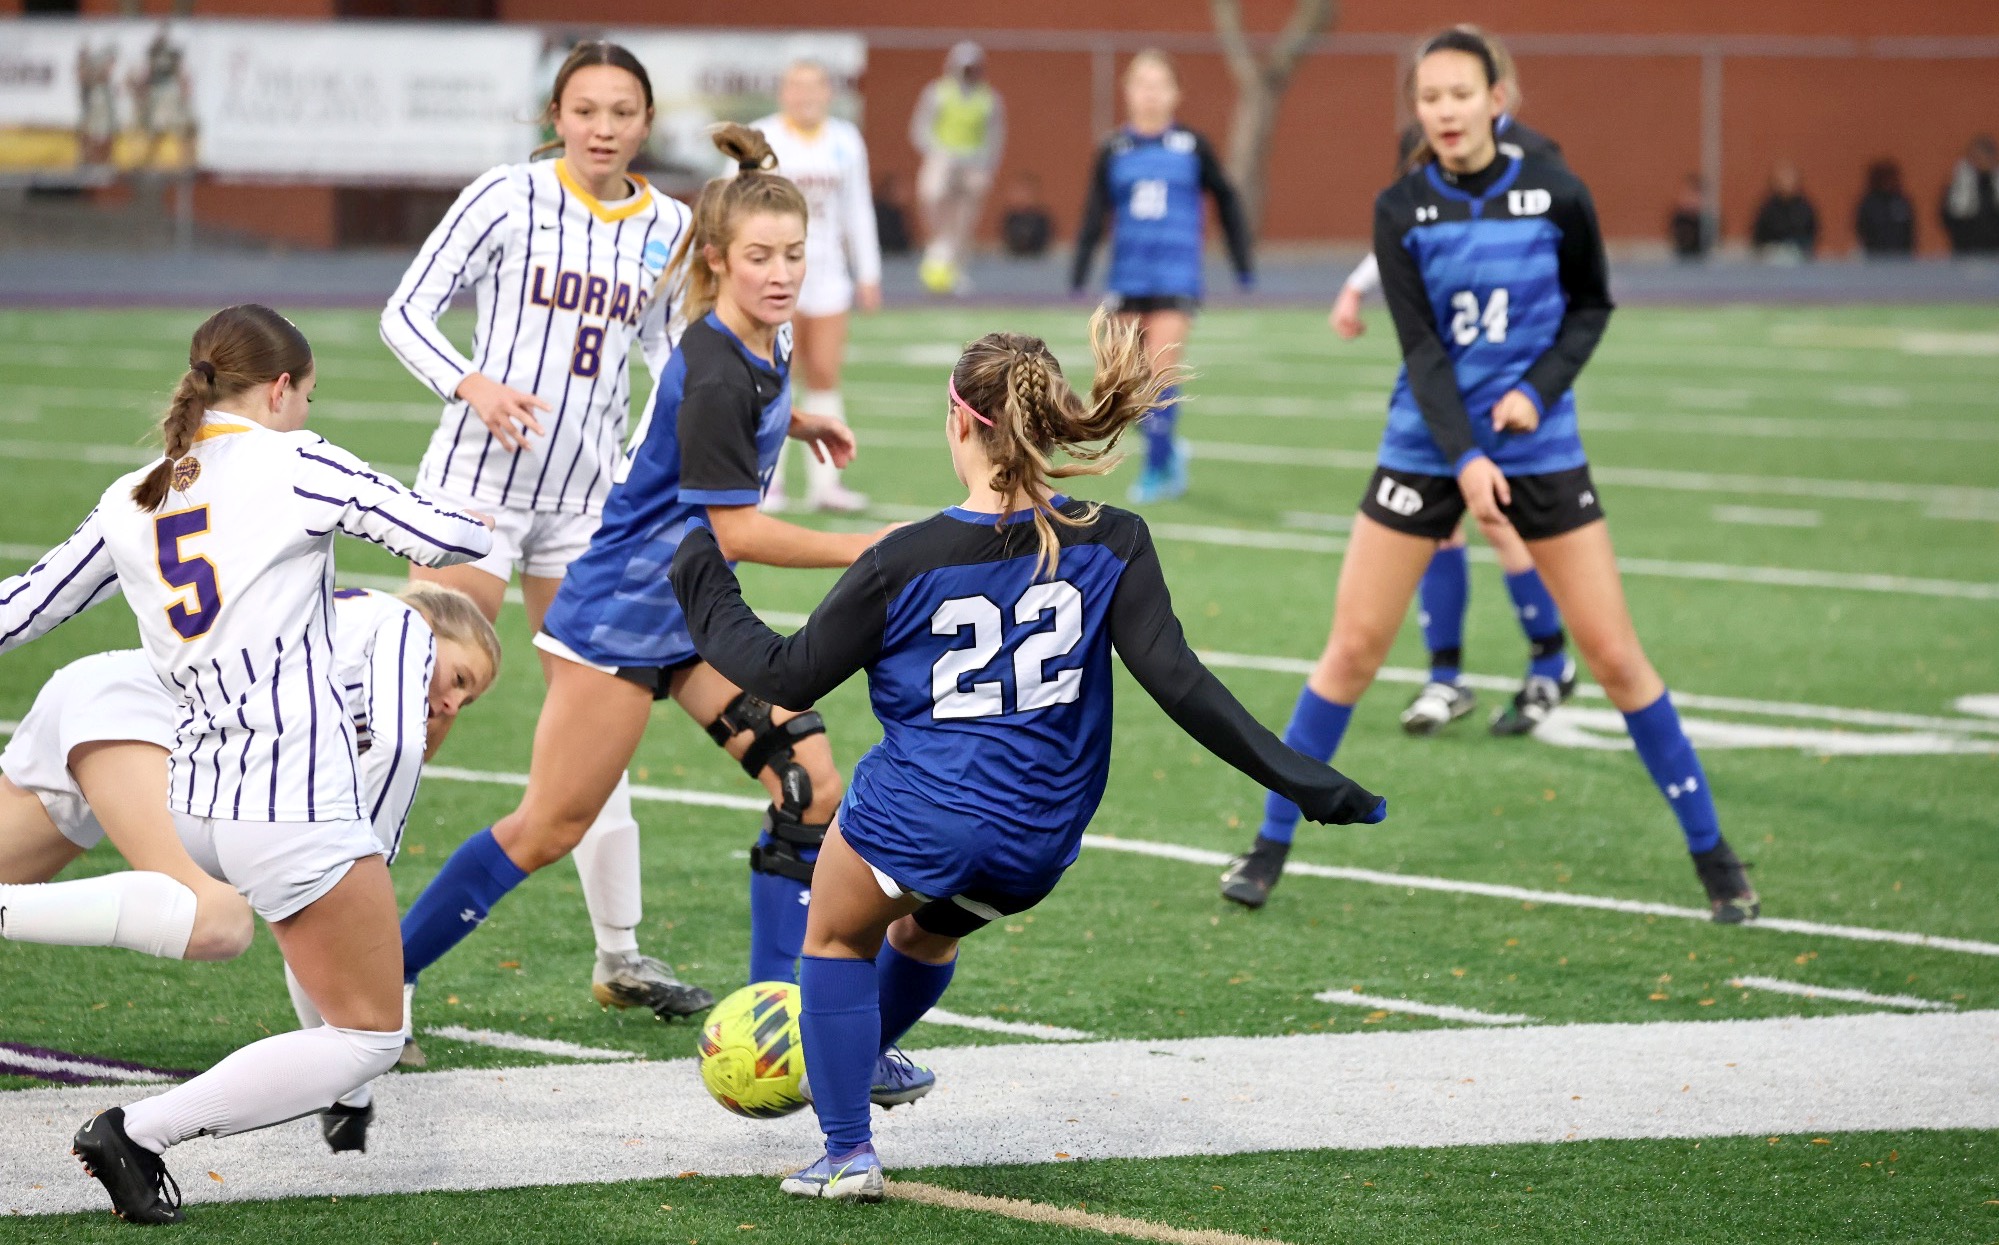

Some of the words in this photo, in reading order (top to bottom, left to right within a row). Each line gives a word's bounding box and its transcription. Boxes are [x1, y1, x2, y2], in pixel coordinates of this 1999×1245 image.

[570, 326, 606, 379] 8
[1450, 287, 1509, 346] 24
[154, 502, 224, 643] 5
[930, 579, 1084, 719] 22
